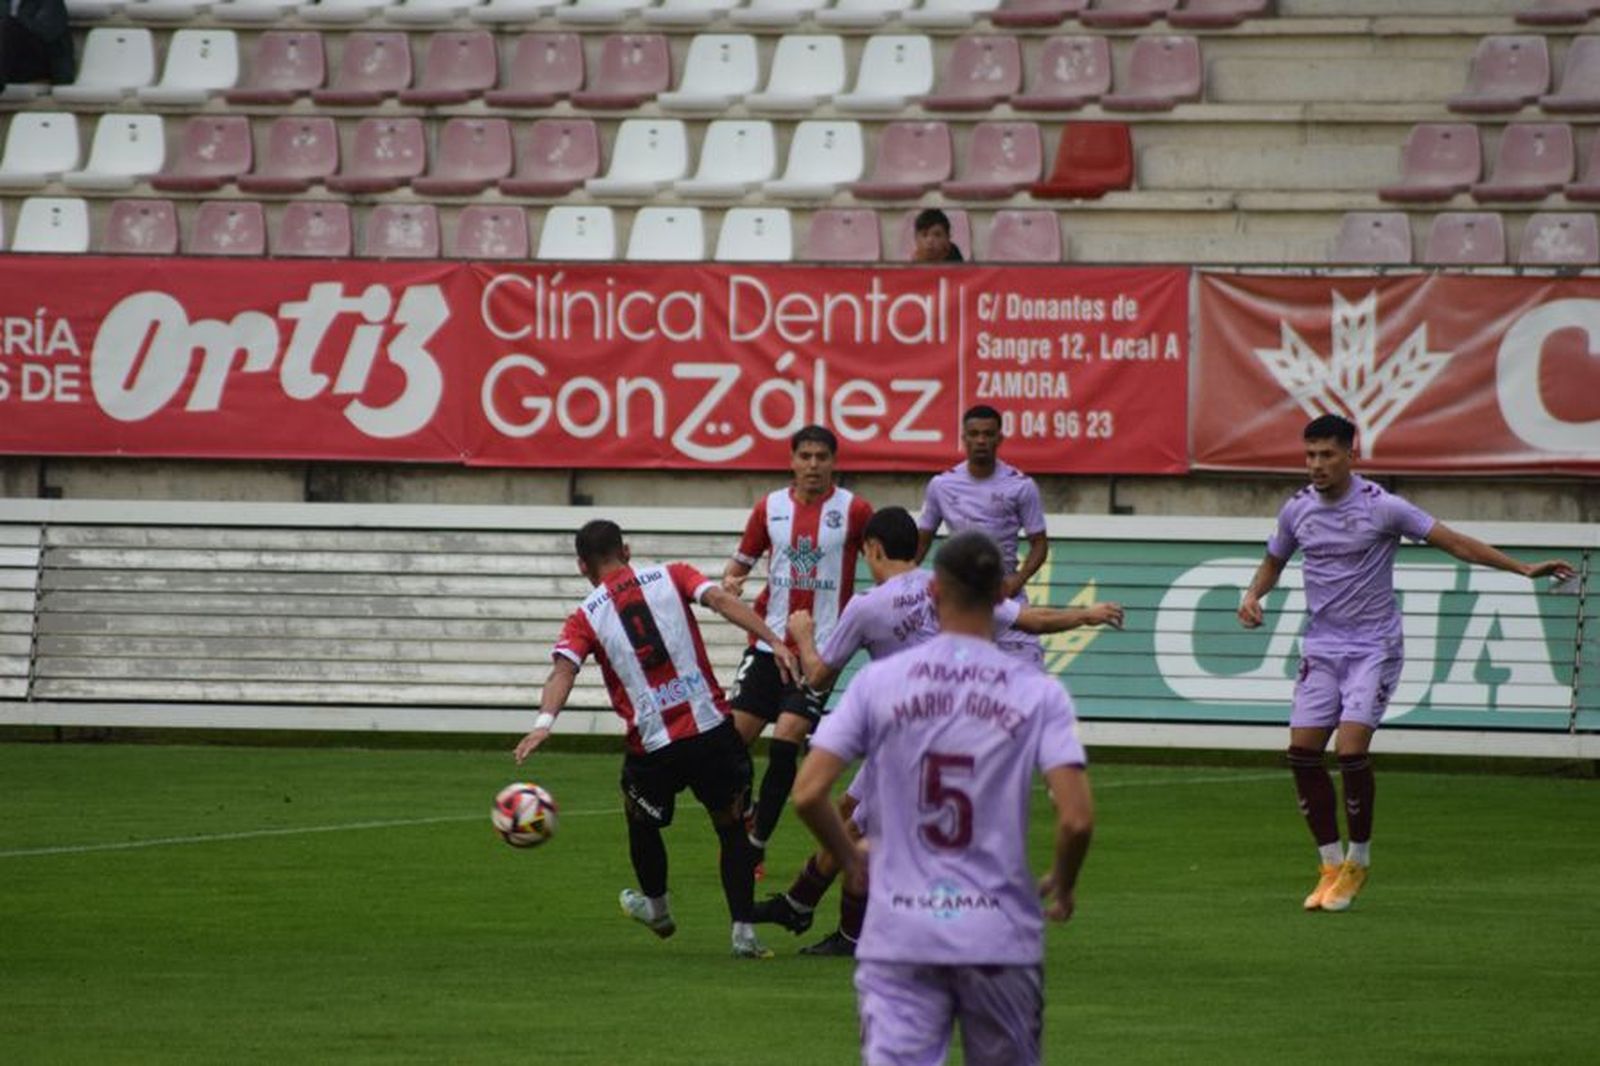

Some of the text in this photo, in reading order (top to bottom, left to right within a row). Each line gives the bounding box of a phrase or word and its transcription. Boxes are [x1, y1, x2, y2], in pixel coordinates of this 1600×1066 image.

[481, 272, 949, 345] Clínica Dental
[1006, 294, 1105, 321] Donantes
[1112, 295, 1138, 321] de
[0, 306, 81, 356] RÍA
[976, 332, 1052, 365] Sangre
[1100, 333, 1157, 361] Local
[1164, 333, 1180, 360] A
[21, 363, 81, 402] DE
[976, 371, 1070, 399] ZAMORA
[1020, 411, 1047, 438] 04
[1053, 411, 1080, 438] 96
[1086, 411, 1114, 438] 23
[620, 602, 672, 671] 9
[893, 692, 954, 728] MARIO
[917, 752, 975, 853] 5
